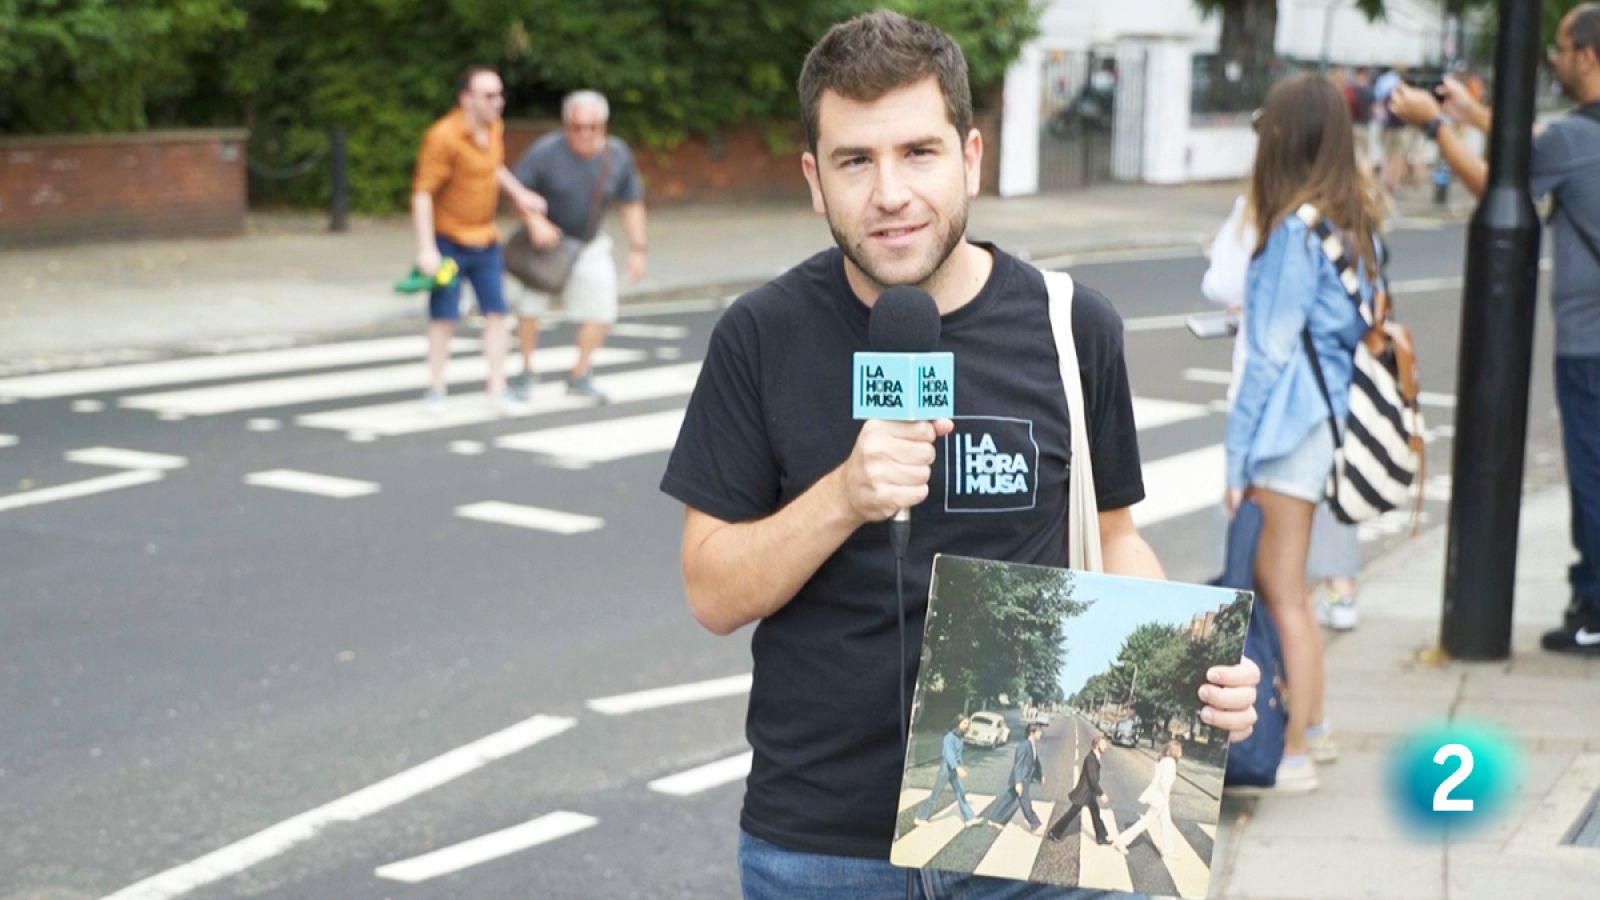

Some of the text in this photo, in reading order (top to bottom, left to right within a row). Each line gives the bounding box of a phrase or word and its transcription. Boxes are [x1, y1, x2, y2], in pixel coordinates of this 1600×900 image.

[866, 365, 884, 378] LA
[922, 366, 936, 378] LA
[866, 379, 903, 393] HORA
[922, 379, 949, 393] HORA
[866, 394, 904, 408] MUSA
[922, 394, 949, 408] MUSA
[964, 432, 997, 453] LA
[965, 452, 1029, 473] HORA
[965, 473, 1029, 494] MUSA
